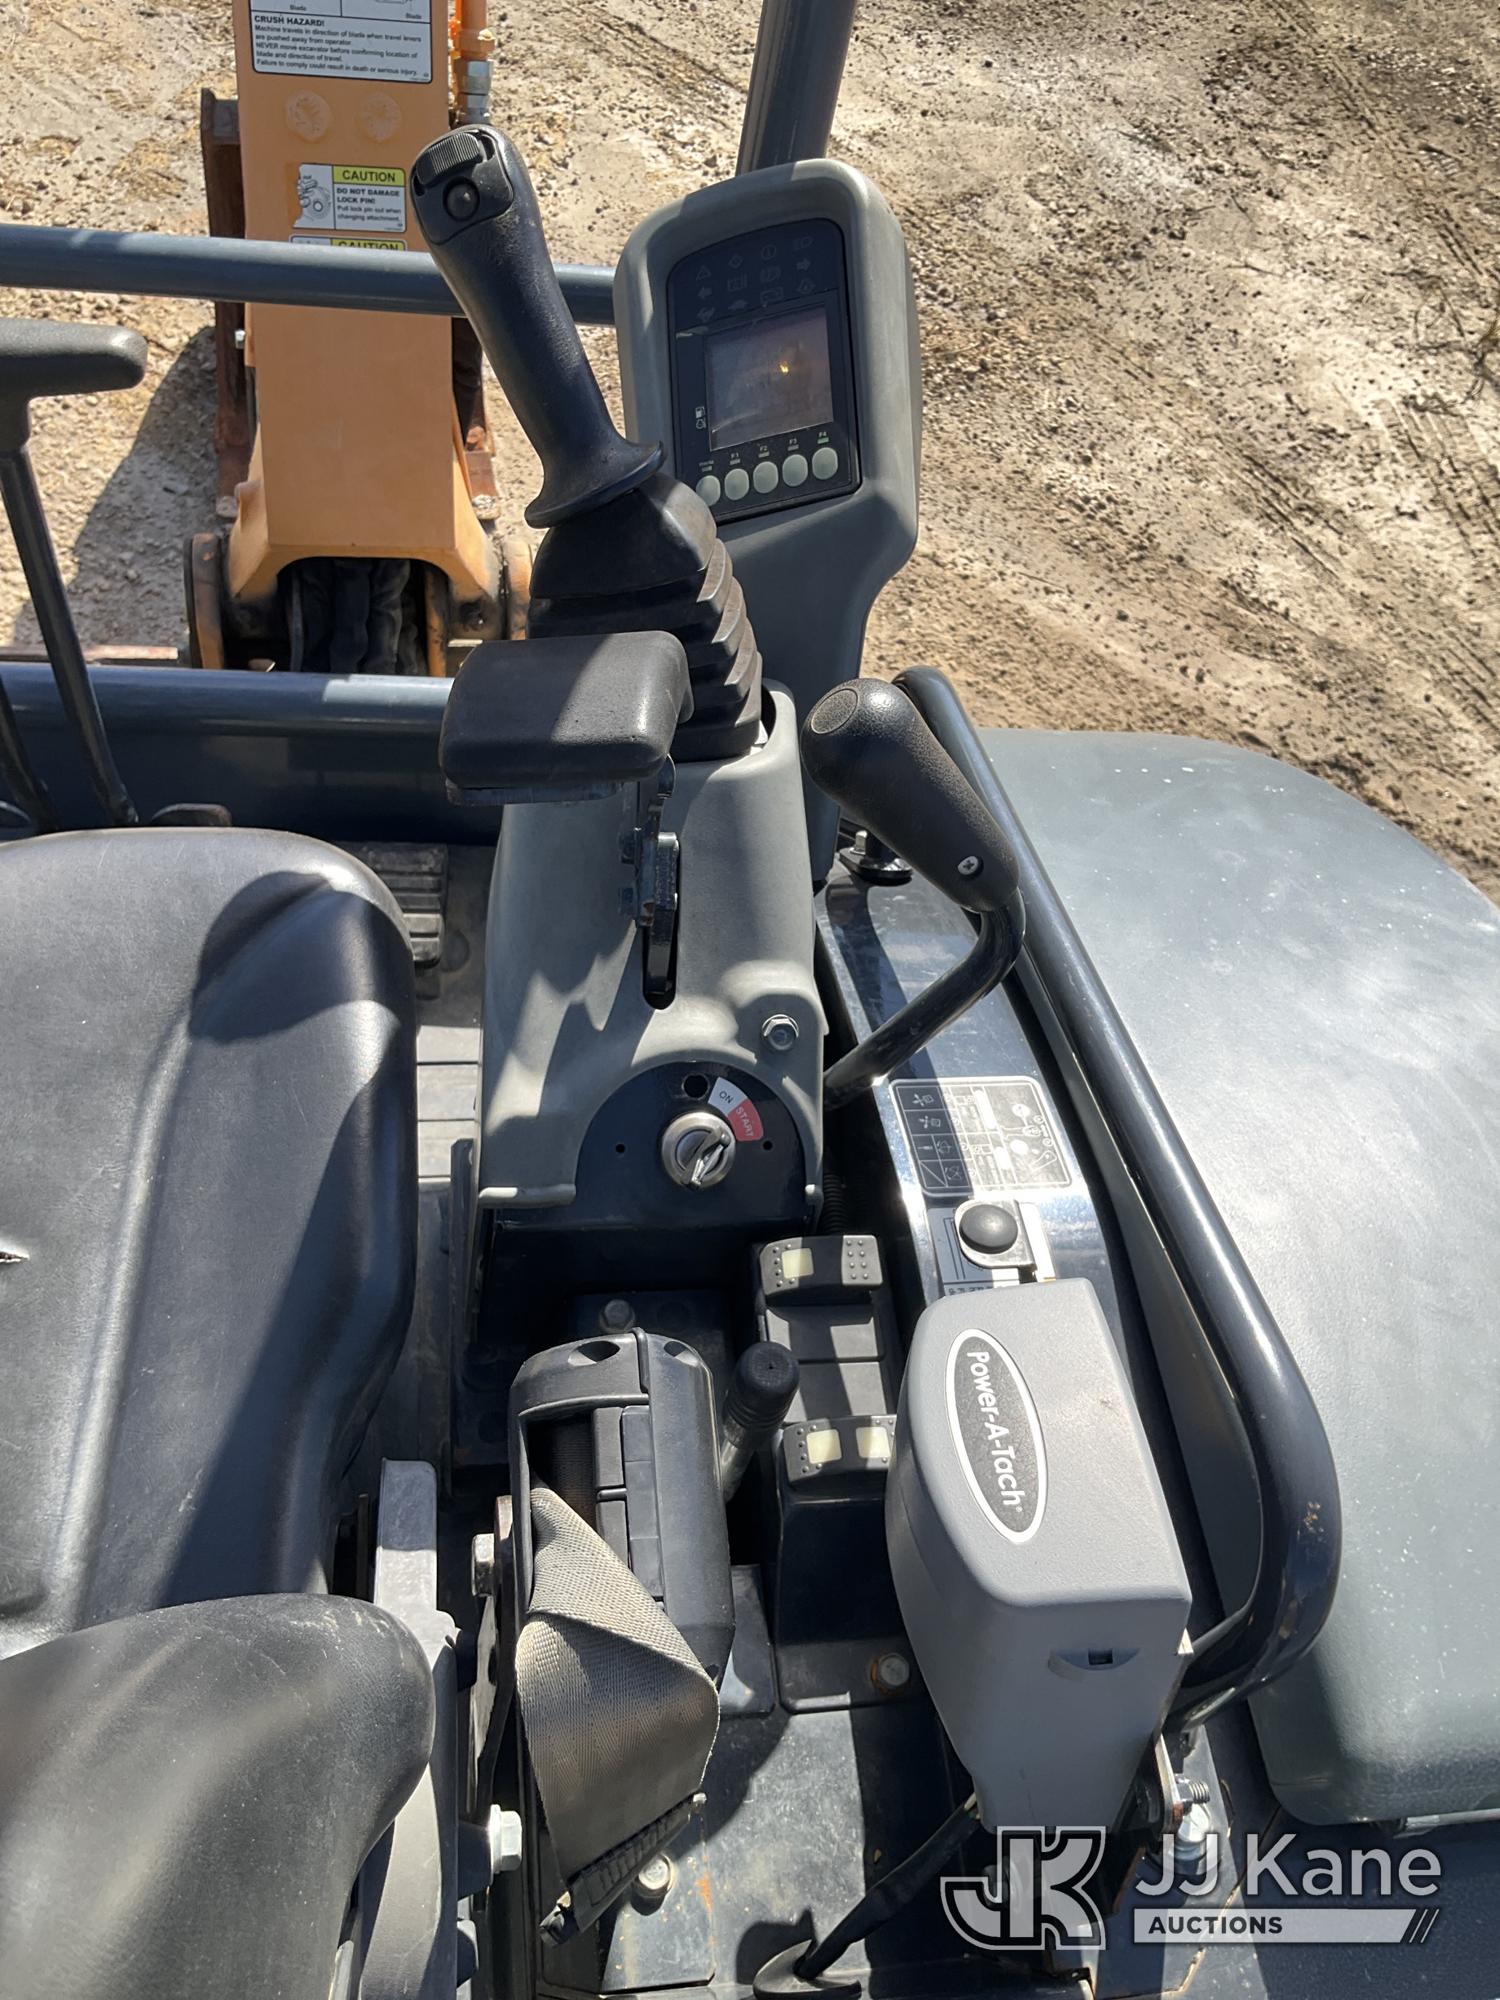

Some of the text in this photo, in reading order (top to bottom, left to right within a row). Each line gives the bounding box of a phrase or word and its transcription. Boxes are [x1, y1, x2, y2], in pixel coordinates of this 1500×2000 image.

[254, 16, 325, 27] CRUSH HAZARD!
[352, 49, 384, 58] confirming
[342, 170, 395, 182] CAUTION
[719, 1091, 734, 1104] ON
[736, 1107, 754, 1136] START
[967, 1352, 1026, 1506] Power-A-Tach
